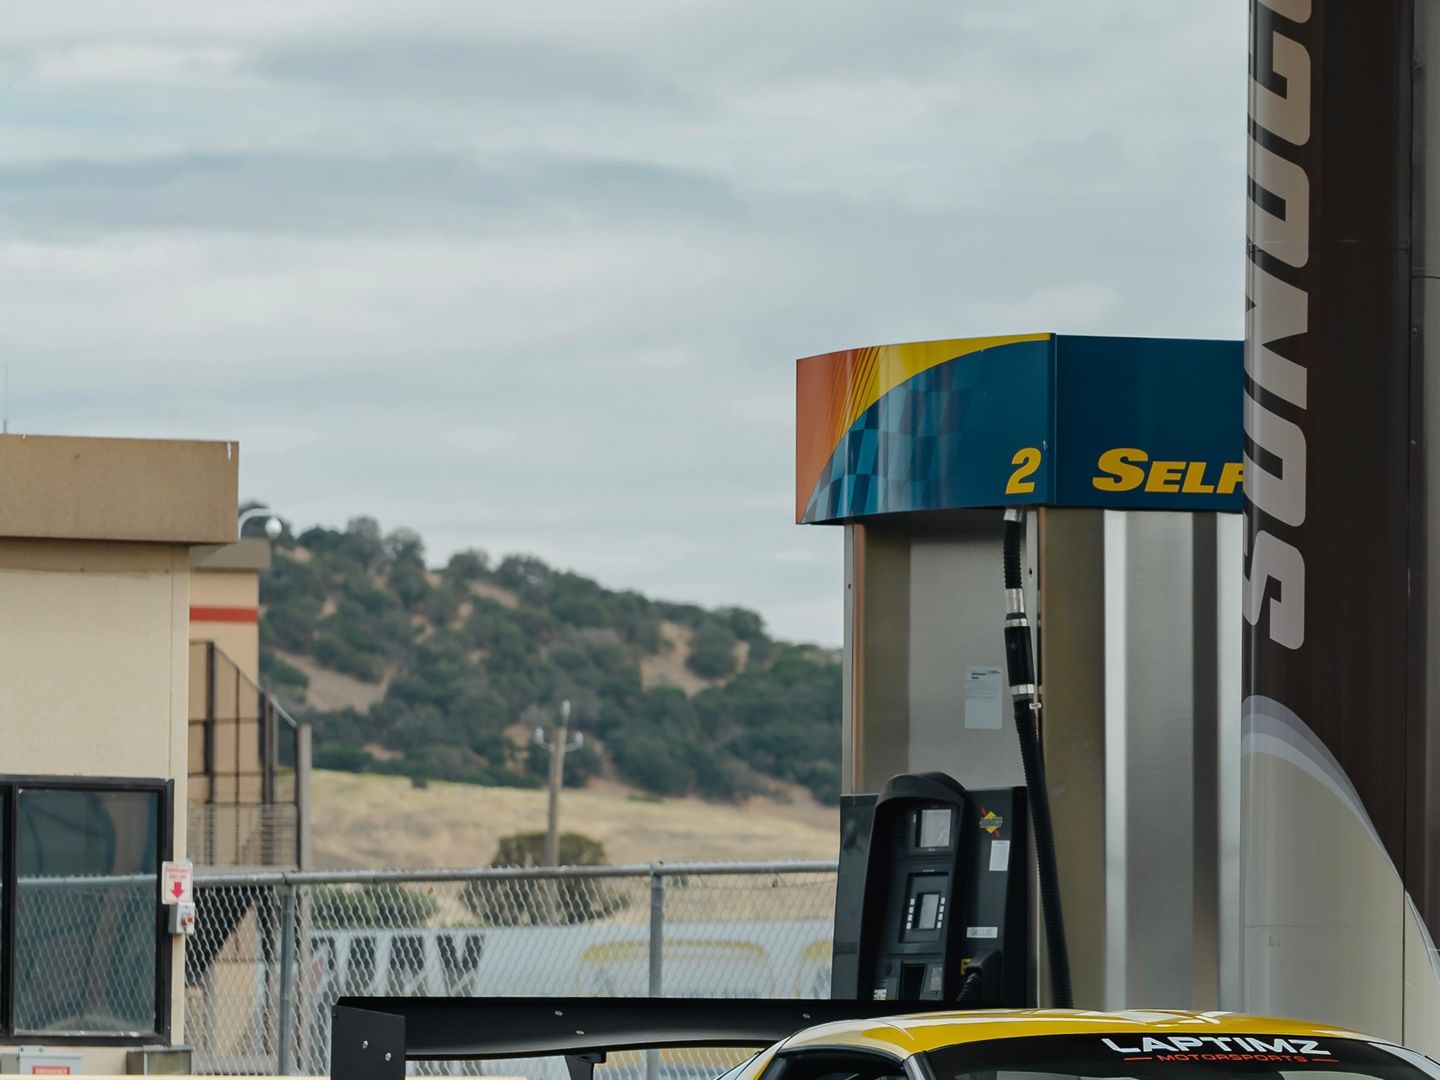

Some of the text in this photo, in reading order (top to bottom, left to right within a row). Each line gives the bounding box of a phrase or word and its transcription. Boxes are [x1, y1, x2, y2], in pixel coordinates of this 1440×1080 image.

[1243, 0, 1313, 650] SUNOC
[1005, 447, 1041, 494] 2
[1101, 1036, 1331, 1056] LAPTIMZ
[1157, 1054, 1309, 1063] MOTORSPORTS
